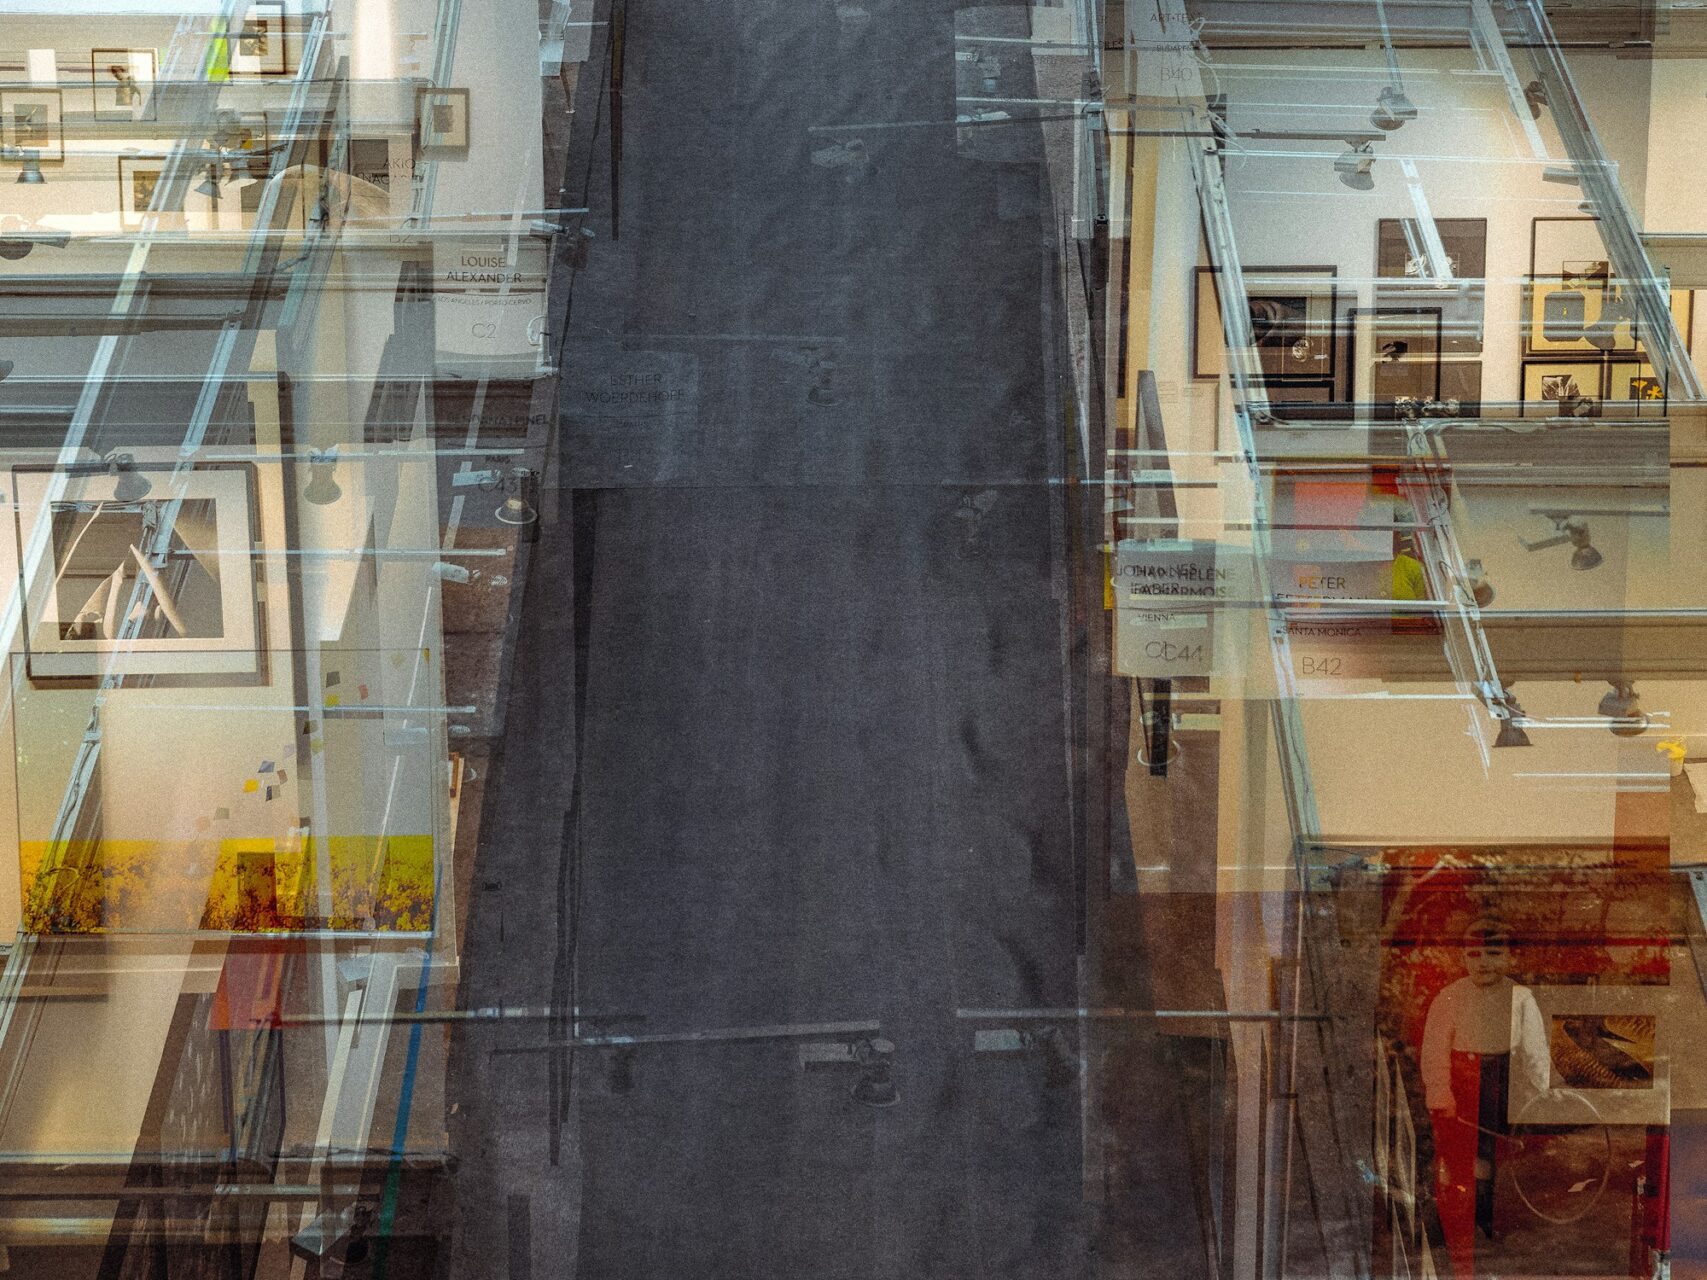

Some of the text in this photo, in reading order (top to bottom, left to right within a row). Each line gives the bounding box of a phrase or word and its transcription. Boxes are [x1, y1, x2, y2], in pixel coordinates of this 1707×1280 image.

[383, 158, 416, 170] AKIO
[461, 255, 507, 268] LOUISE
[446, 271, 523, 283] ALEXANDER
[471, 322, 497, 339] C2
[1299, 576, 1346, 589] PETER
[1281, 626, 1362, 637] SANTA MONICA
[1302, 656, 1343, 675] B42
